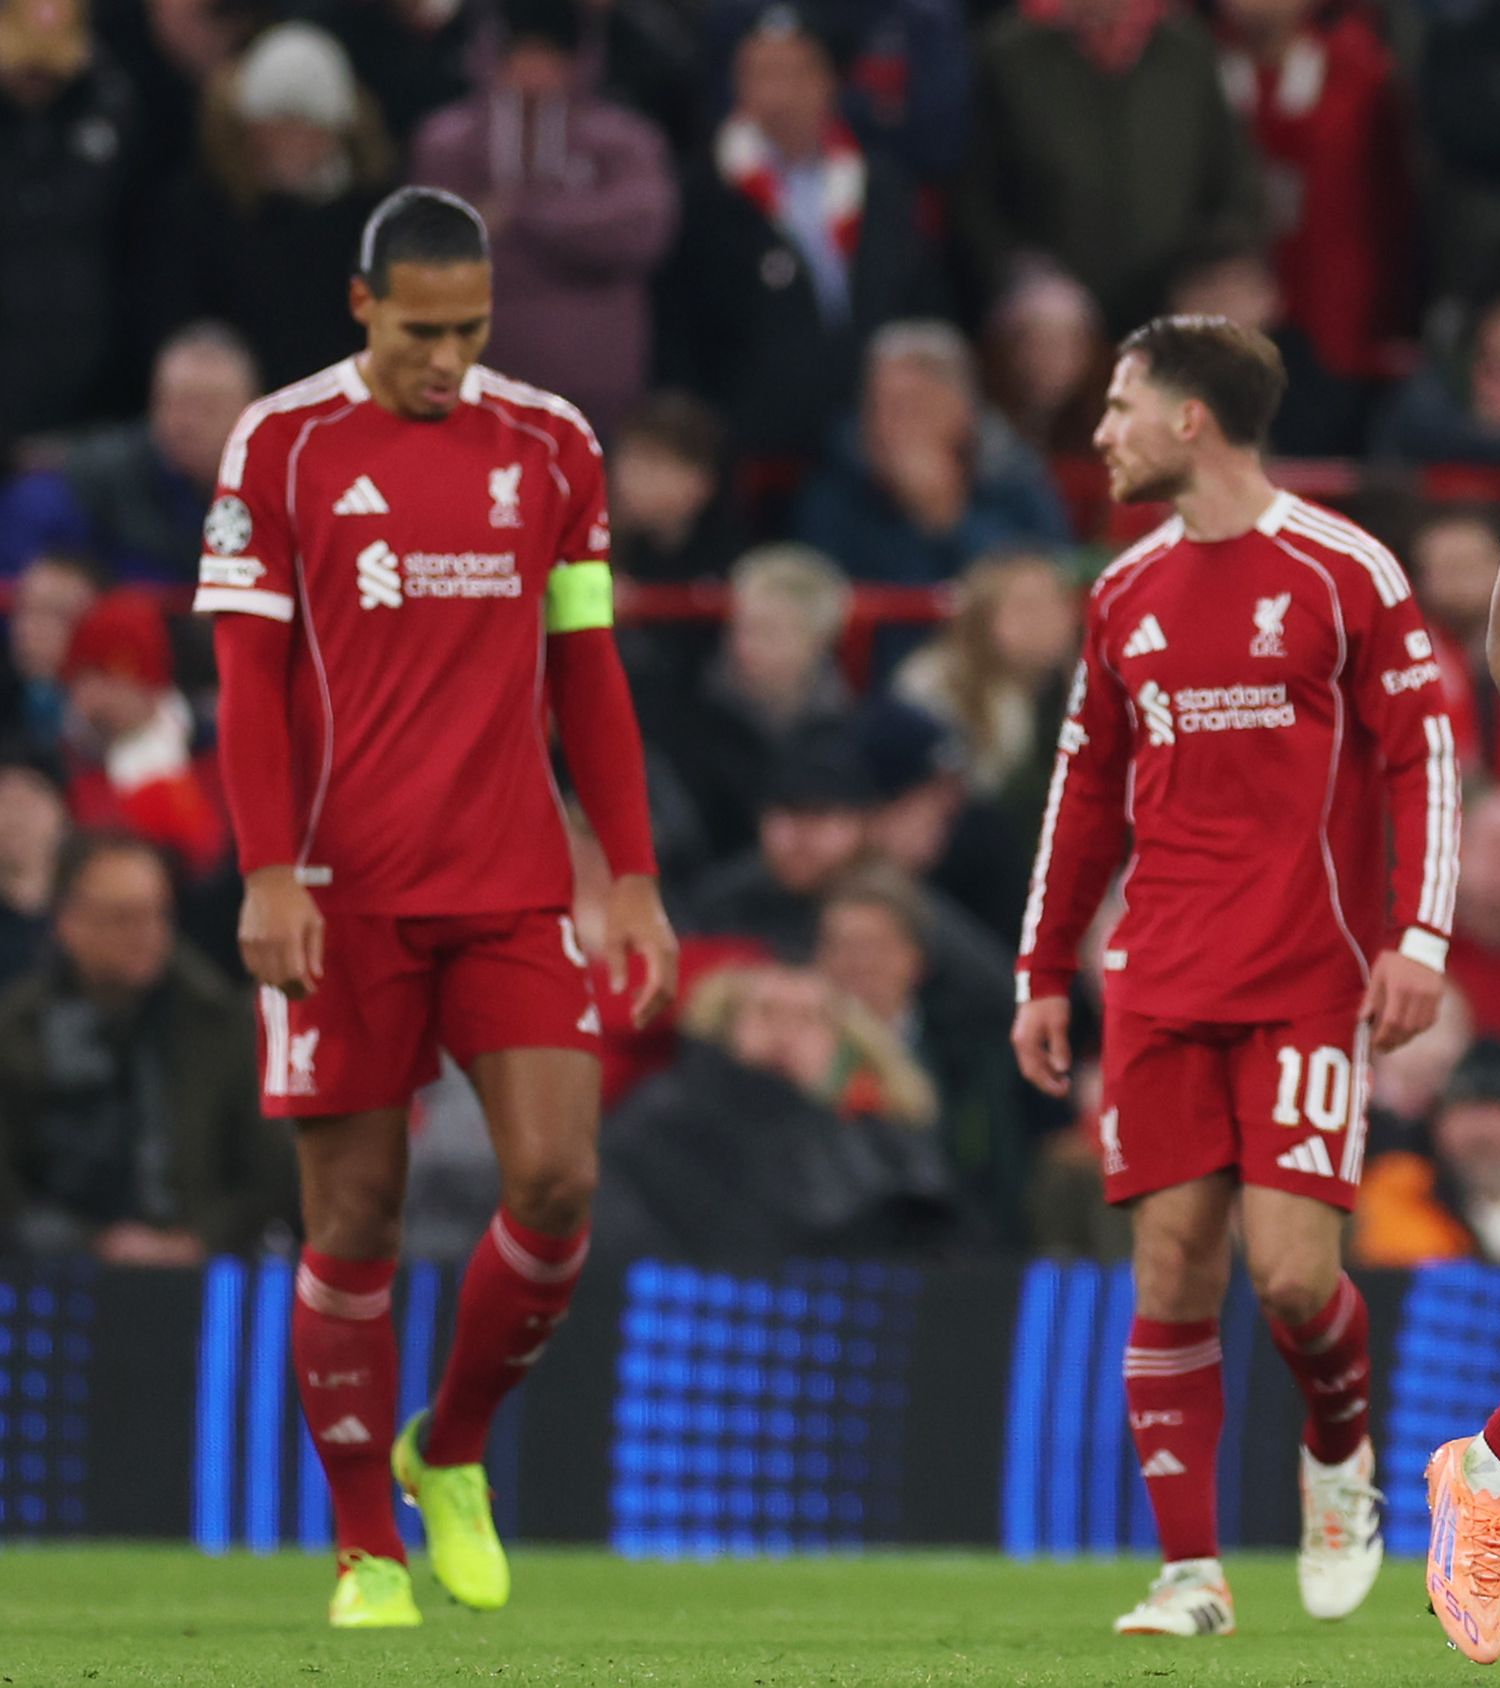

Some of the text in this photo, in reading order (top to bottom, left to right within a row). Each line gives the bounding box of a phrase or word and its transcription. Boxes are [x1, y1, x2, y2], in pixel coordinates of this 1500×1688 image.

[1175, 682, 1287, 711] standard
[1177, 702, 1297, 734] chartered
[1272, 1044, 1351, 1132] 10
